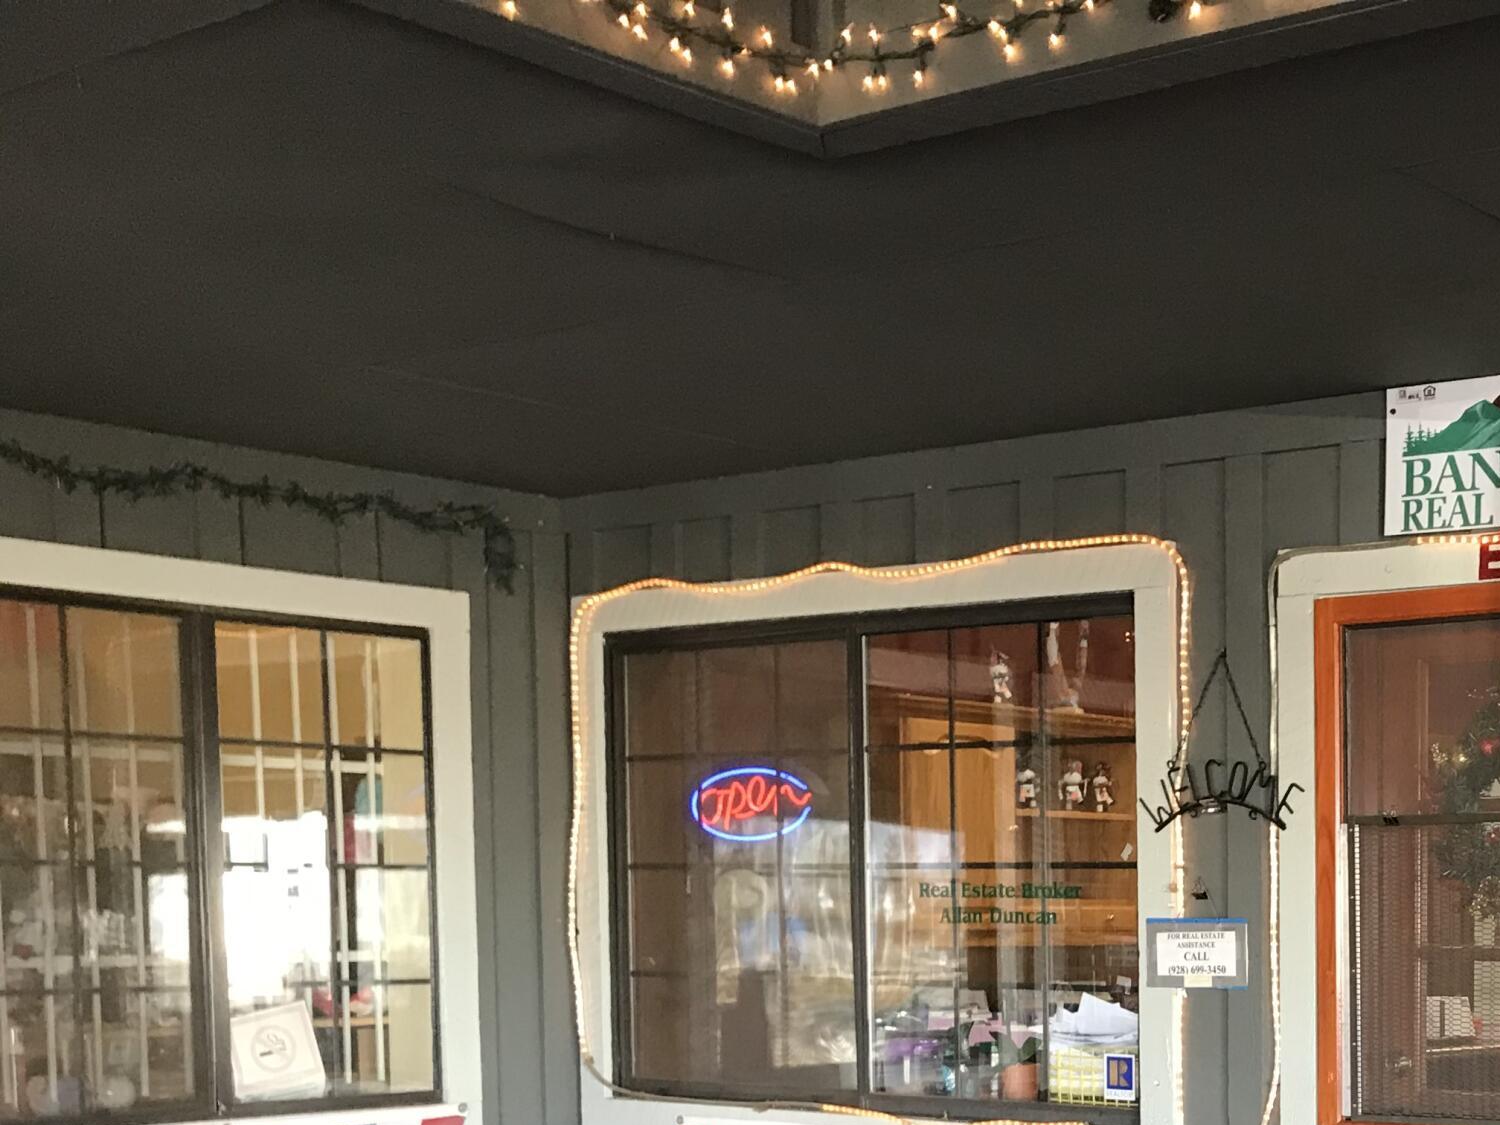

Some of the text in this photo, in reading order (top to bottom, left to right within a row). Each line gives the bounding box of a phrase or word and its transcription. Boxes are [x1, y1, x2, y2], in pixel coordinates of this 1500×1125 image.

[1401, 493, 1494, 532] REAL
[1139, 758, 1306, 828] WELCOME
[918, 879, 1082, 898] Real Estate Broker
[940, 907, 1057, 924] Allan Duncan
[1167, 932, 1225, 940] FOR REAL ESTATE
[1177, 941, 1216, 949] ASSISTANCE
[1183, 951, 1210, 961] CALL
[1168, 965, 1189, 975] (928)
